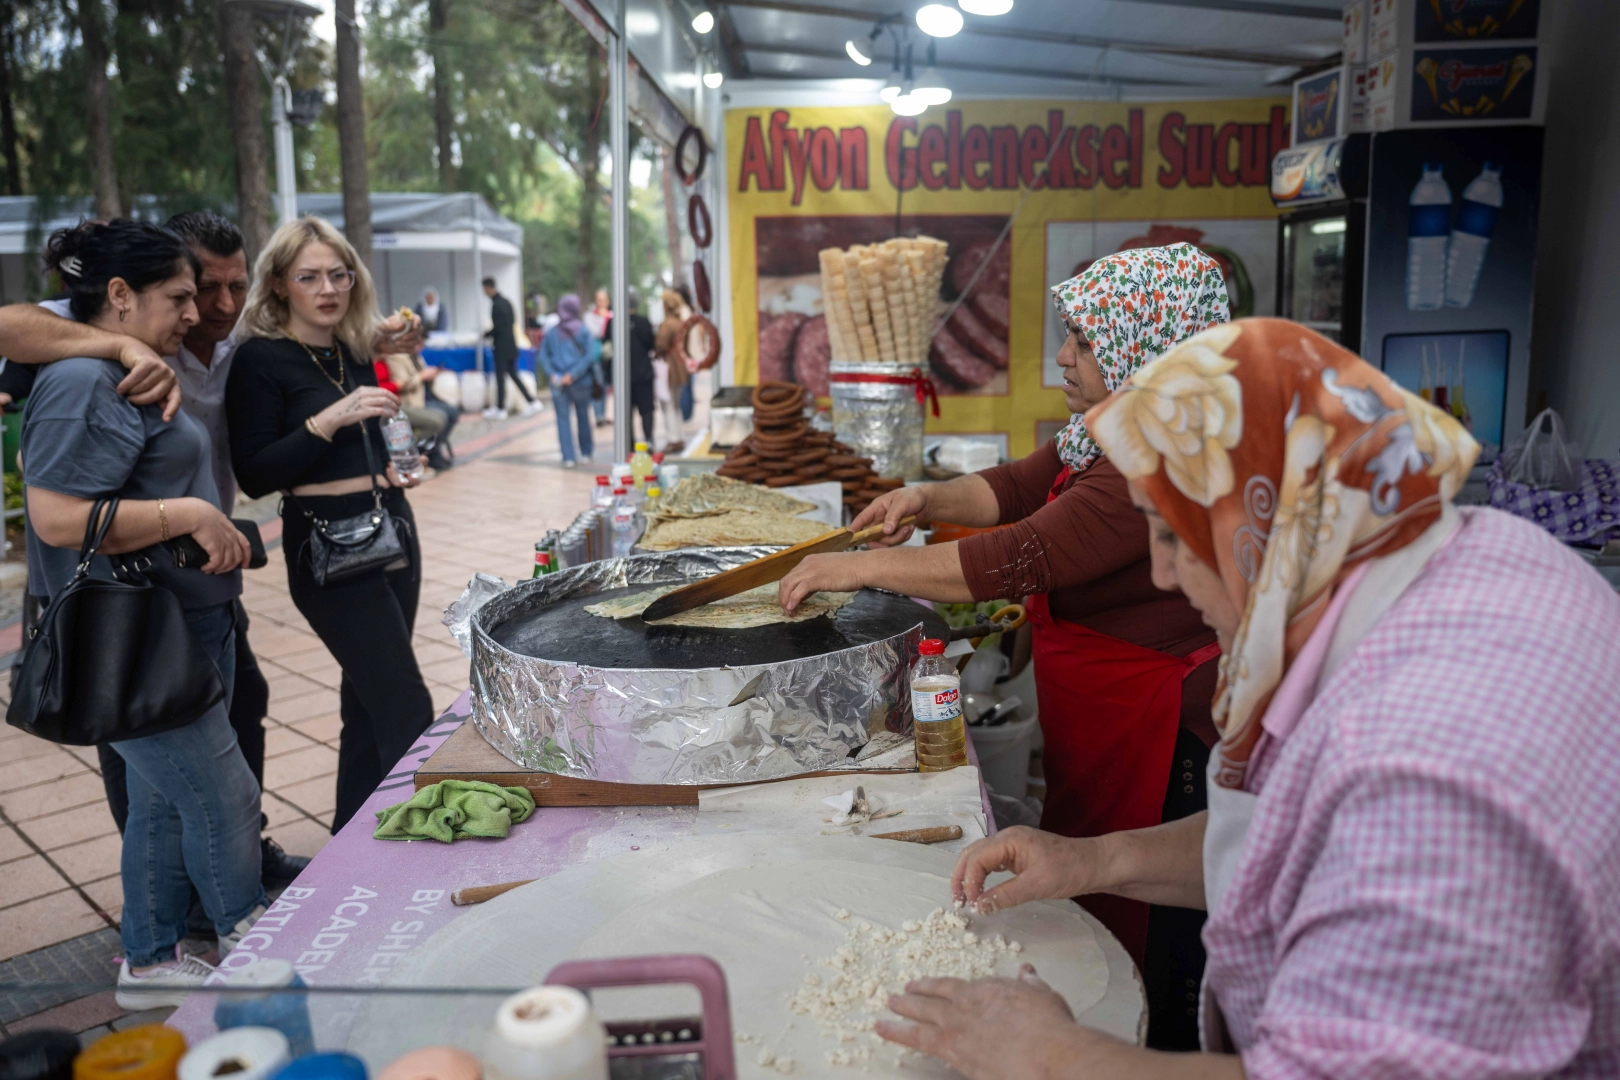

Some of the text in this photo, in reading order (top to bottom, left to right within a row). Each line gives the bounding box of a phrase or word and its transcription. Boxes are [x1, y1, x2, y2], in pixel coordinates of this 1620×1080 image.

[738, 109, 870, 205] Afyon
[885, 107, 1144, 190] Geleneksel
[937, 692, 957, 702] Dalga
[293, 885, 379, 985] ACADEM
[356, 889, 445, 983] BY SHEK
